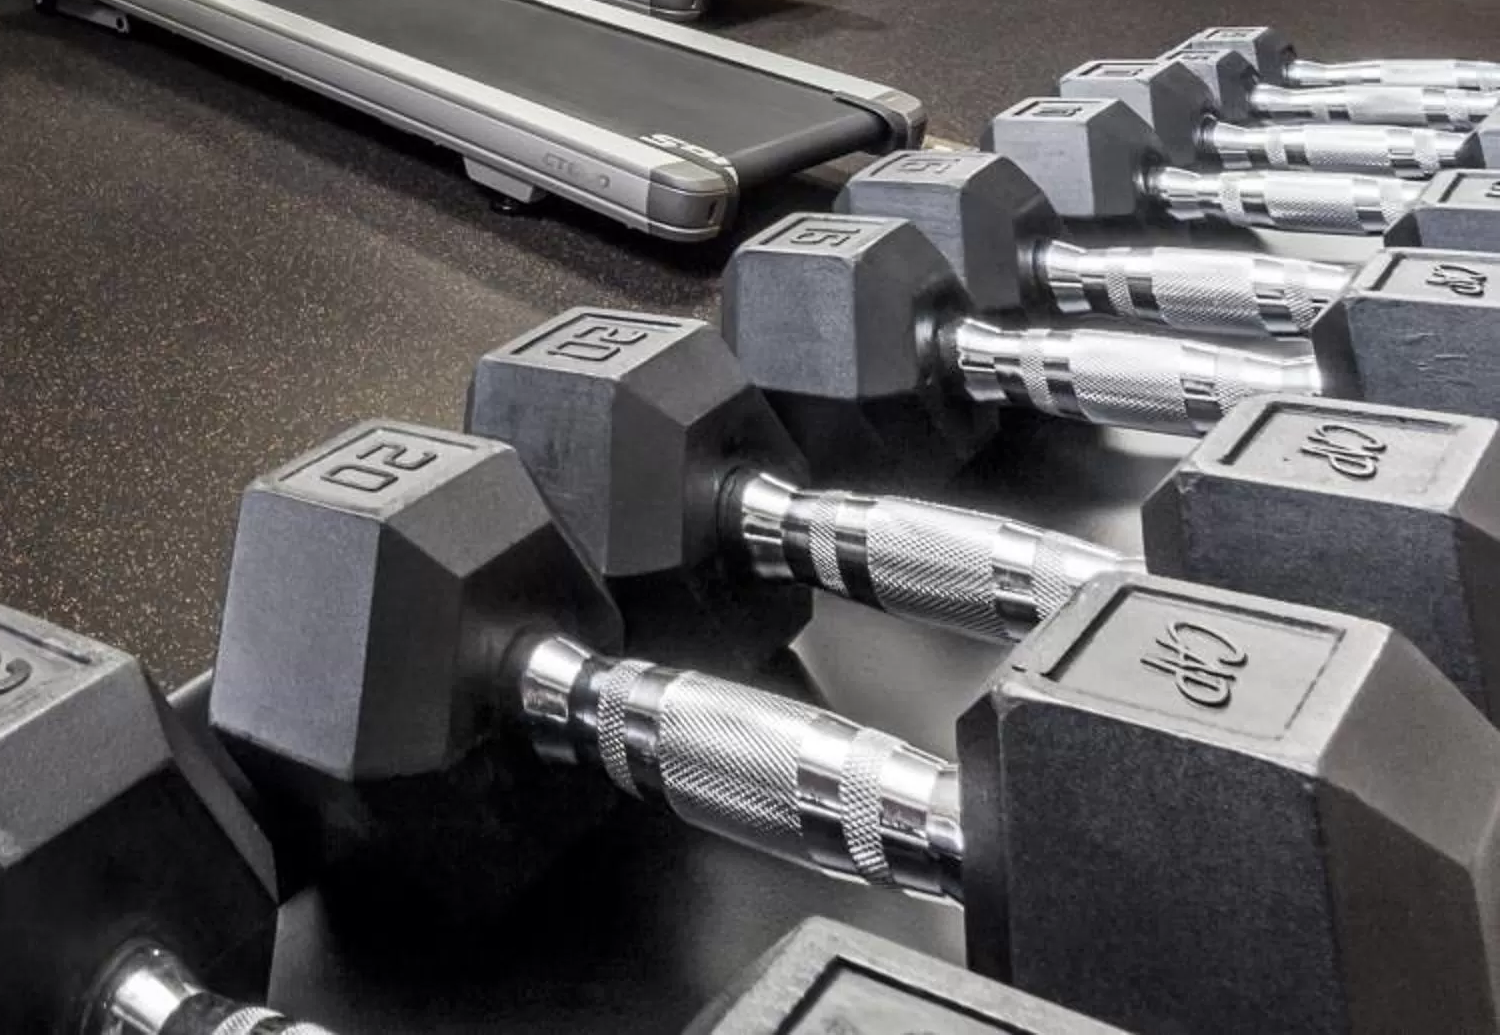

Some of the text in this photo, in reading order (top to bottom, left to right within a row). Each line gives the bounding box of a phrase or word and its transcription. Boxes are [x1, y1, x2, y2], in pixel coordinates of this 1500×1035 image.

[790, 227, 860, 247] 15
[547, 326, 647, 361] 20
[320, 442, 438, 493] 20
[1140, 621, 1249, 710] CAP
